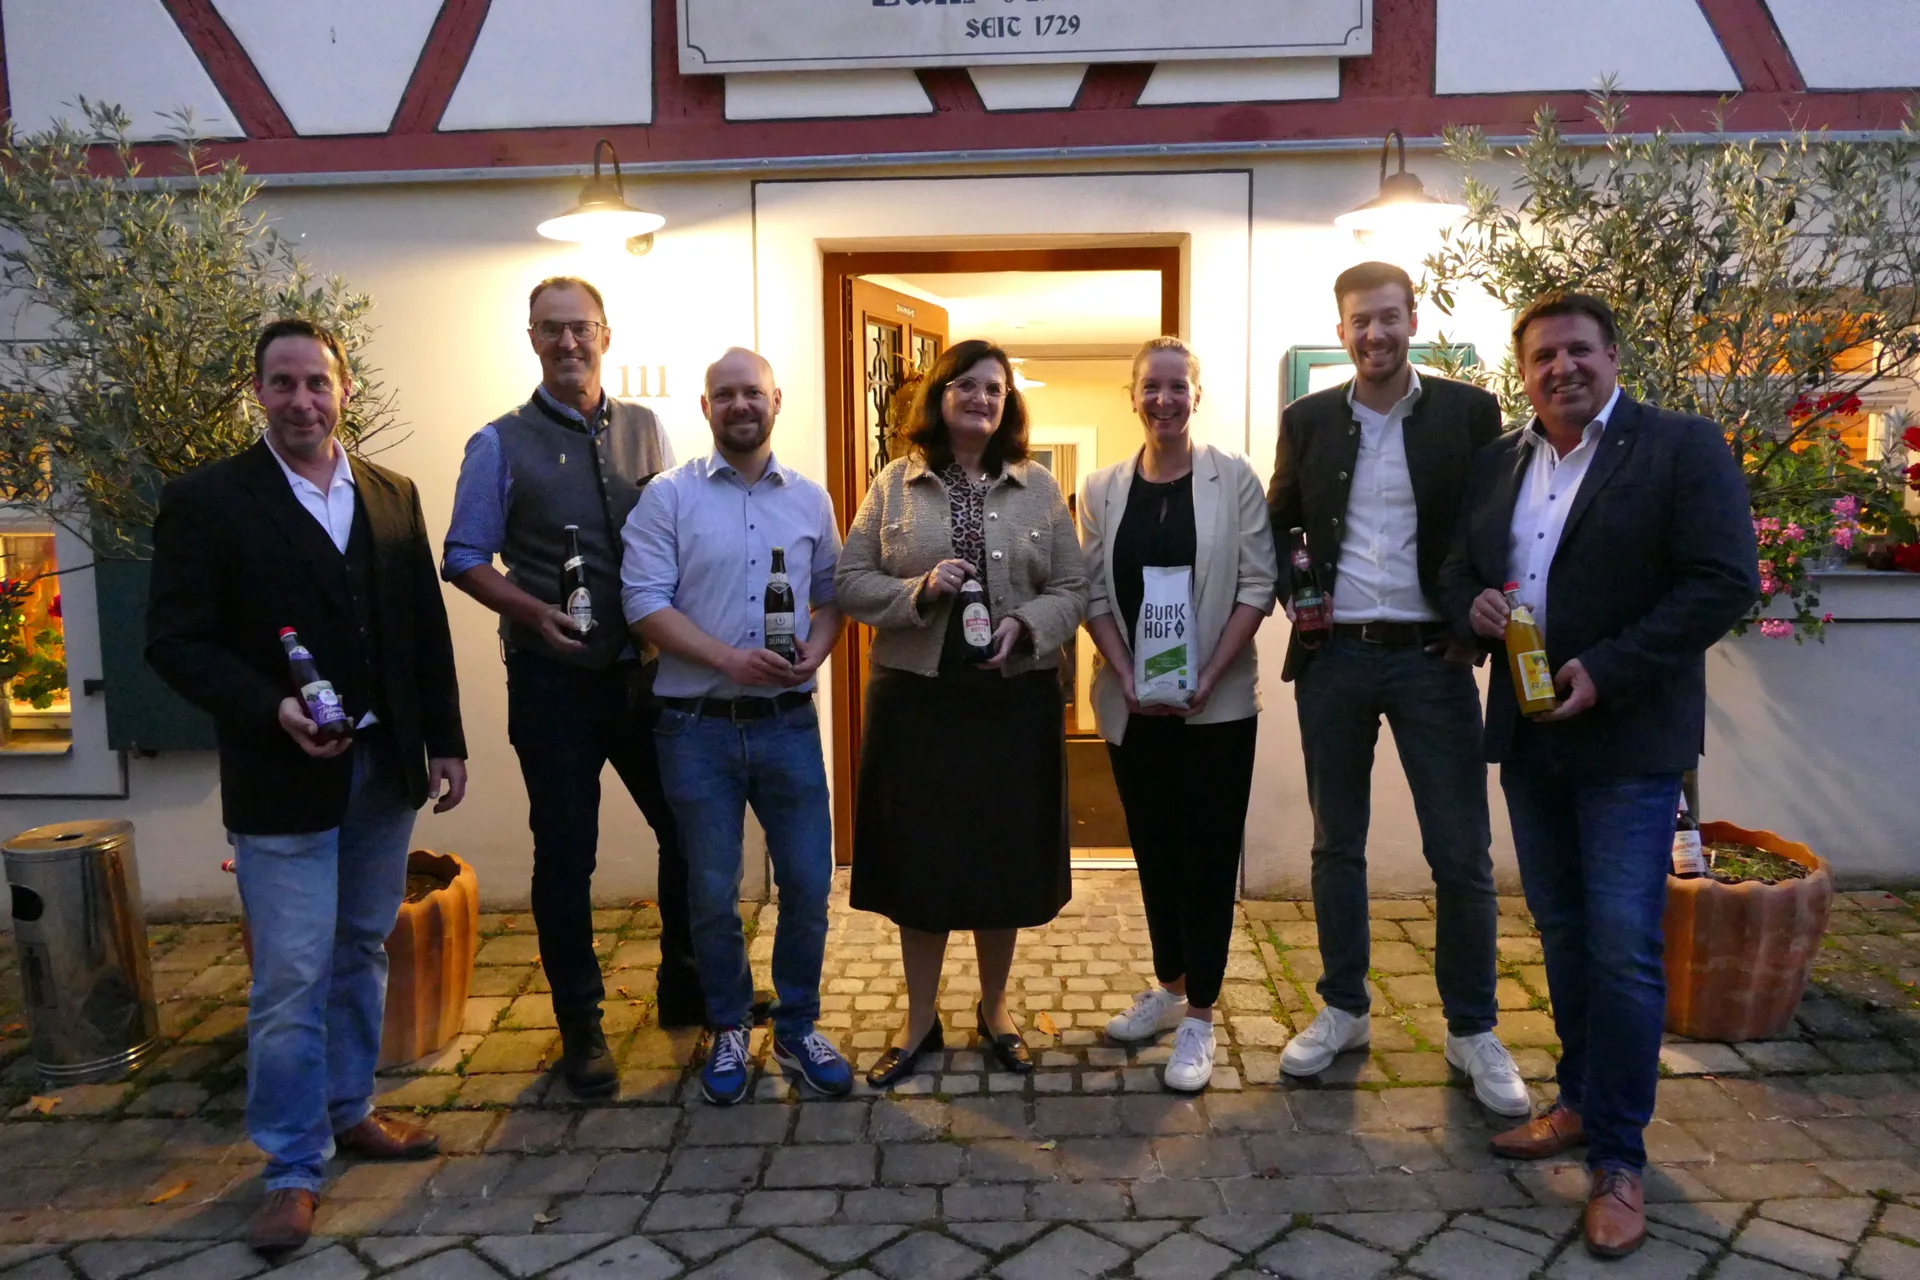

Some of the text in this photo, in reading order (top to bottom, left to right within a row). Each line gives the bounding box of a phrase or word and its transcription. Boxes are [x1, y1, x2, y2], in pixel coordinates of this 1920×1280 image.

[964, 15, 1081, 38] SEIT 1729
[617, 364, 671, 398] 111
[1144, 603, 1186, 621] BURK
[1144, 621, 1172, 639] HOF
